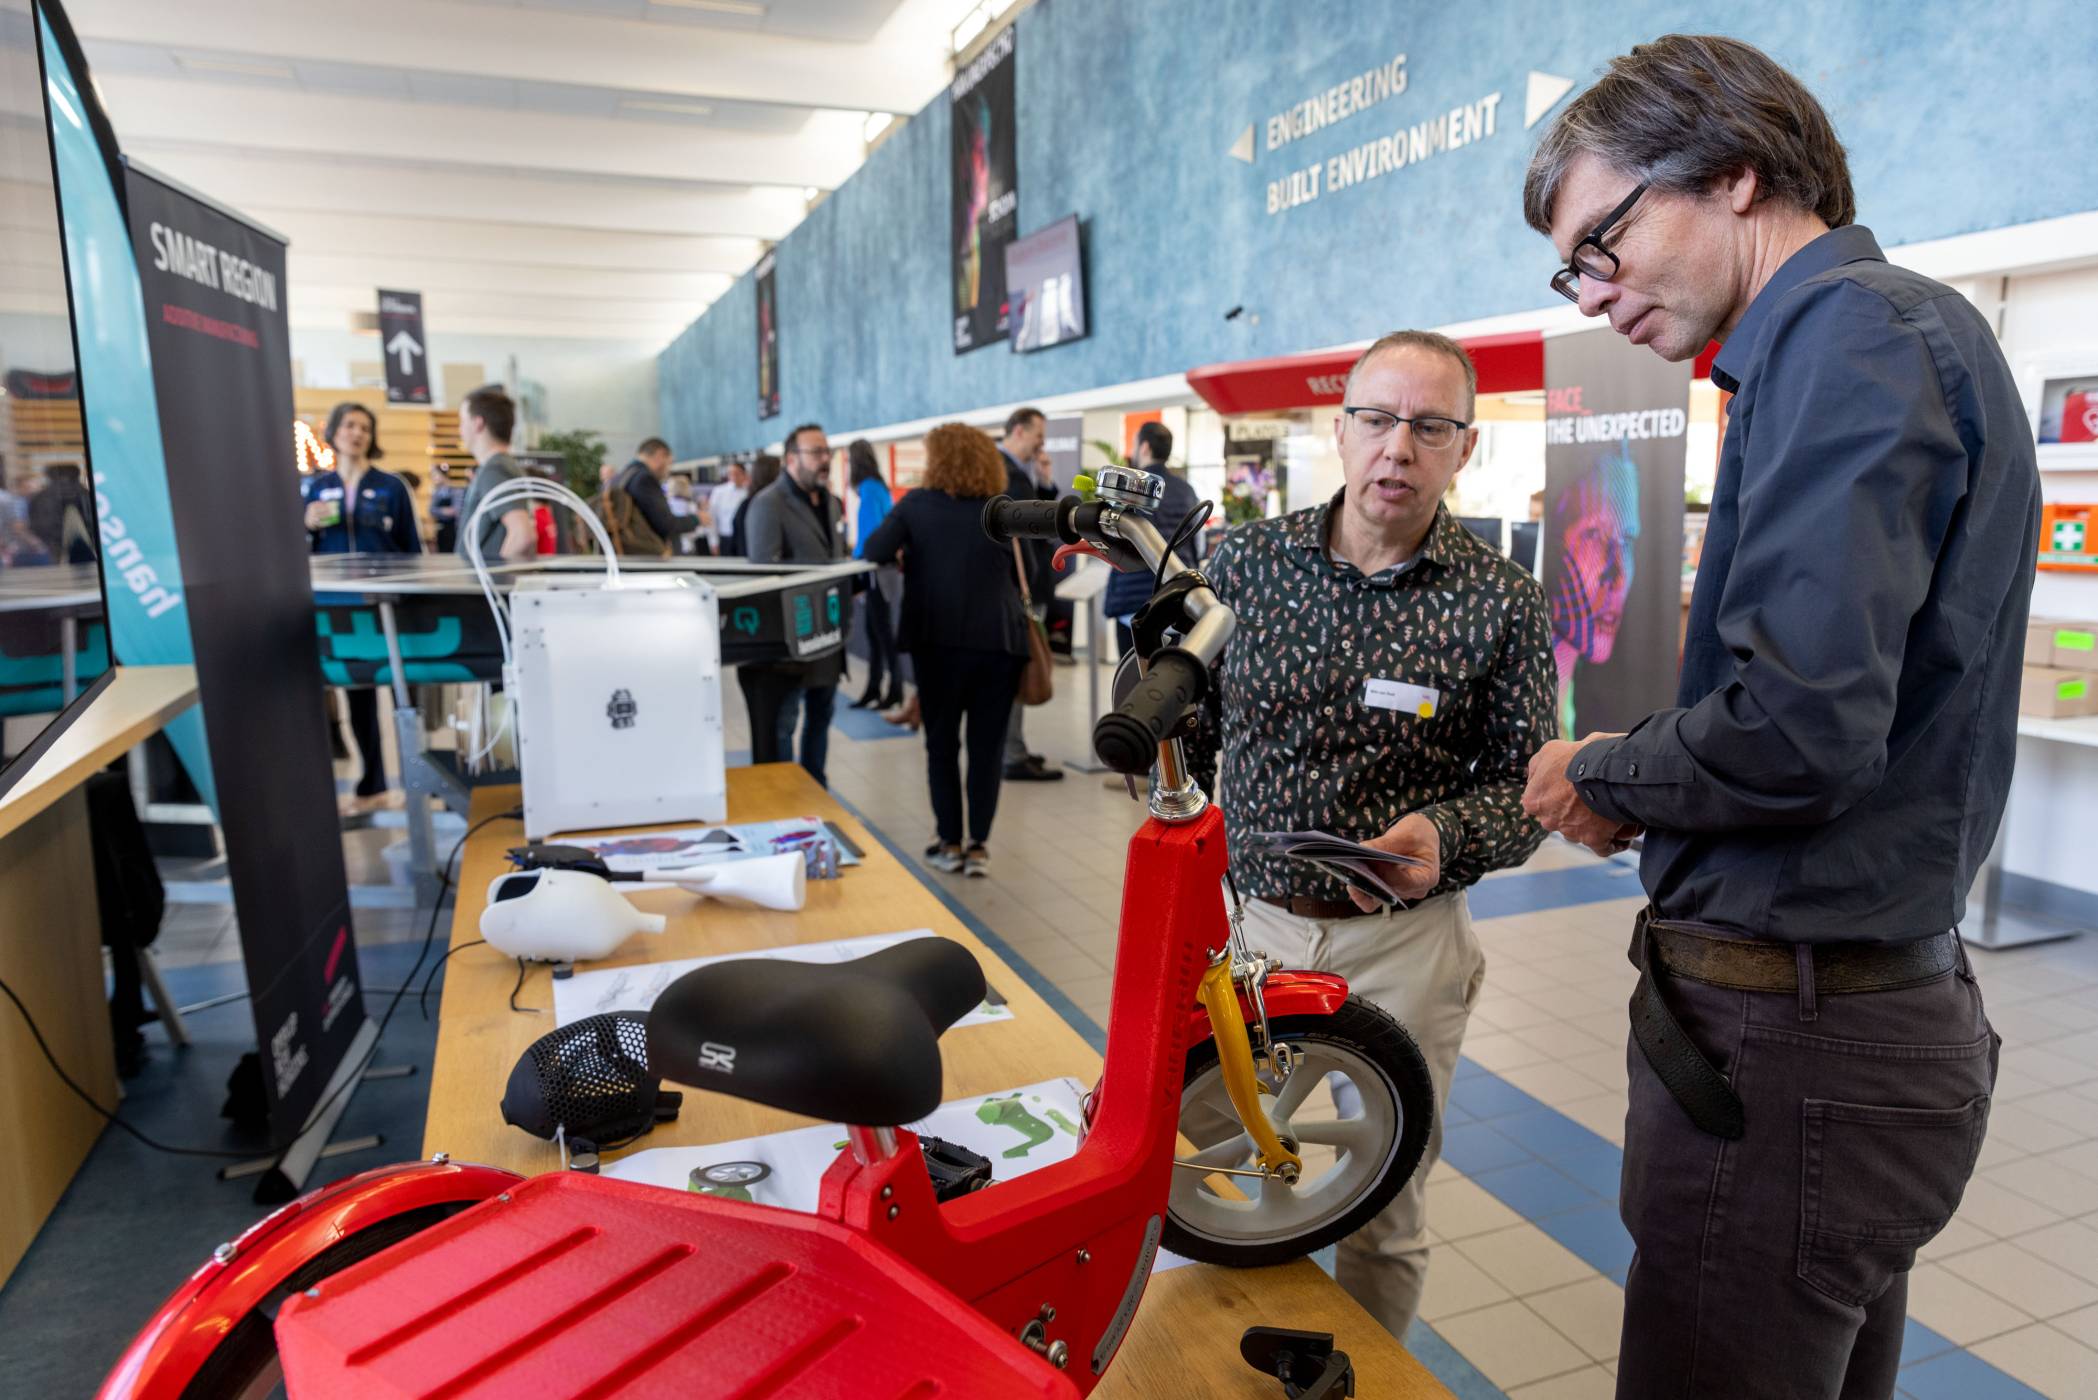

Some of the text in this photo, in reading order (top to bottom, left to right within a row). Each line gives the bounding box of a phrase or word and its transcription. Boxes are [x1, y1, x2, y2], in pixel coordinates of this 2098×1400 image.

[1267, 53, 1408, 151] ENGINEERING
[1266, 91, 1502, 216] BUILT ENVIRONMENT
[150, 221, 278, 312] SMART REGION
[1547, 407, 1686, 444] THE UNEXPECTED
